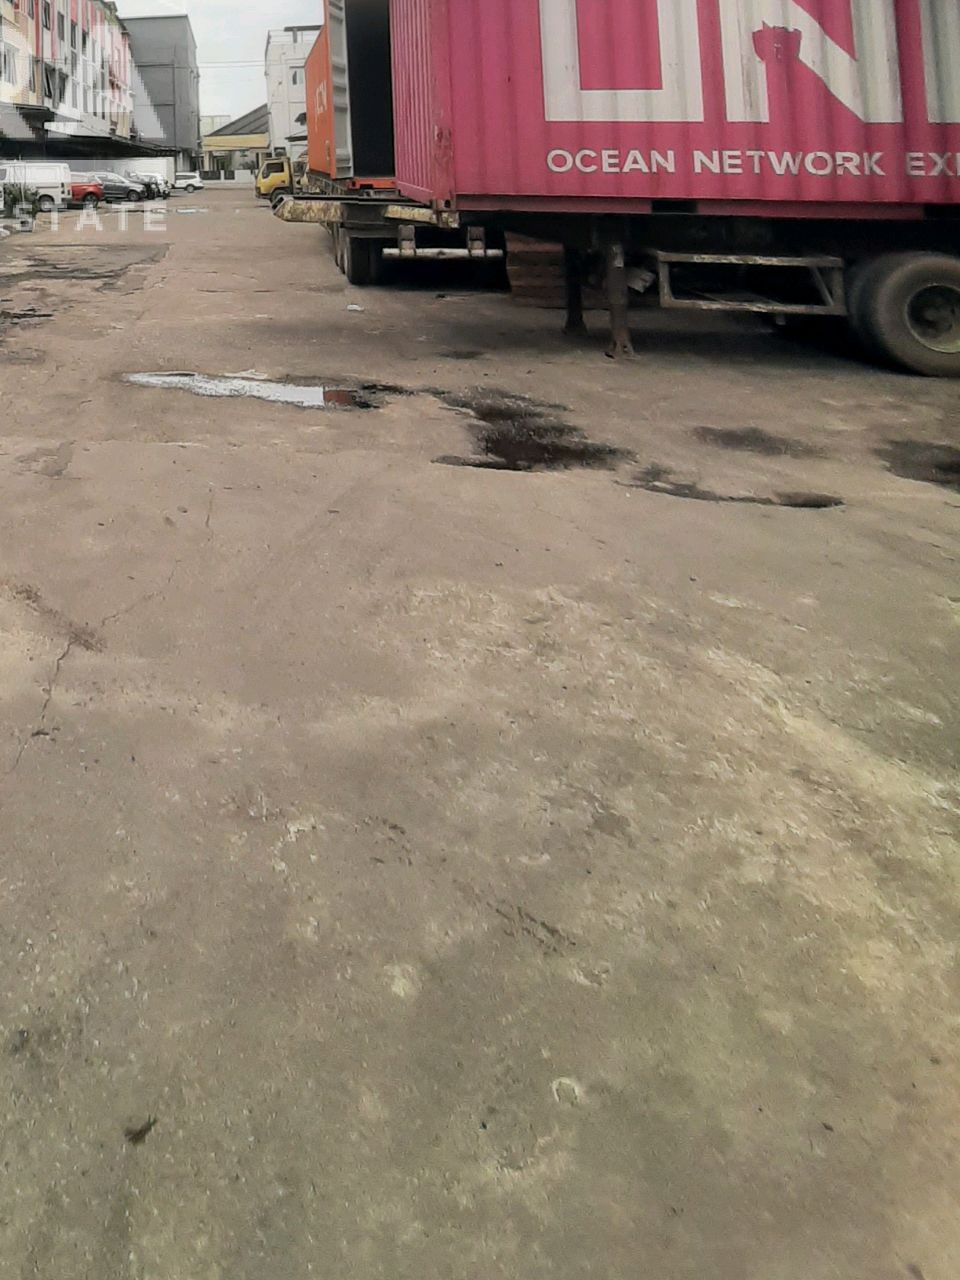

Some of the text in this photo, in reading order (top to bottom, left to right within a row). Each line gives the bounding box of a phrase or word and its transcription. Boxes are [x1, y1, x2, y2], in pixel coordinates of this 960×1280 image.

[546, 149, 960, 177] OCEAN NETWORK EX
